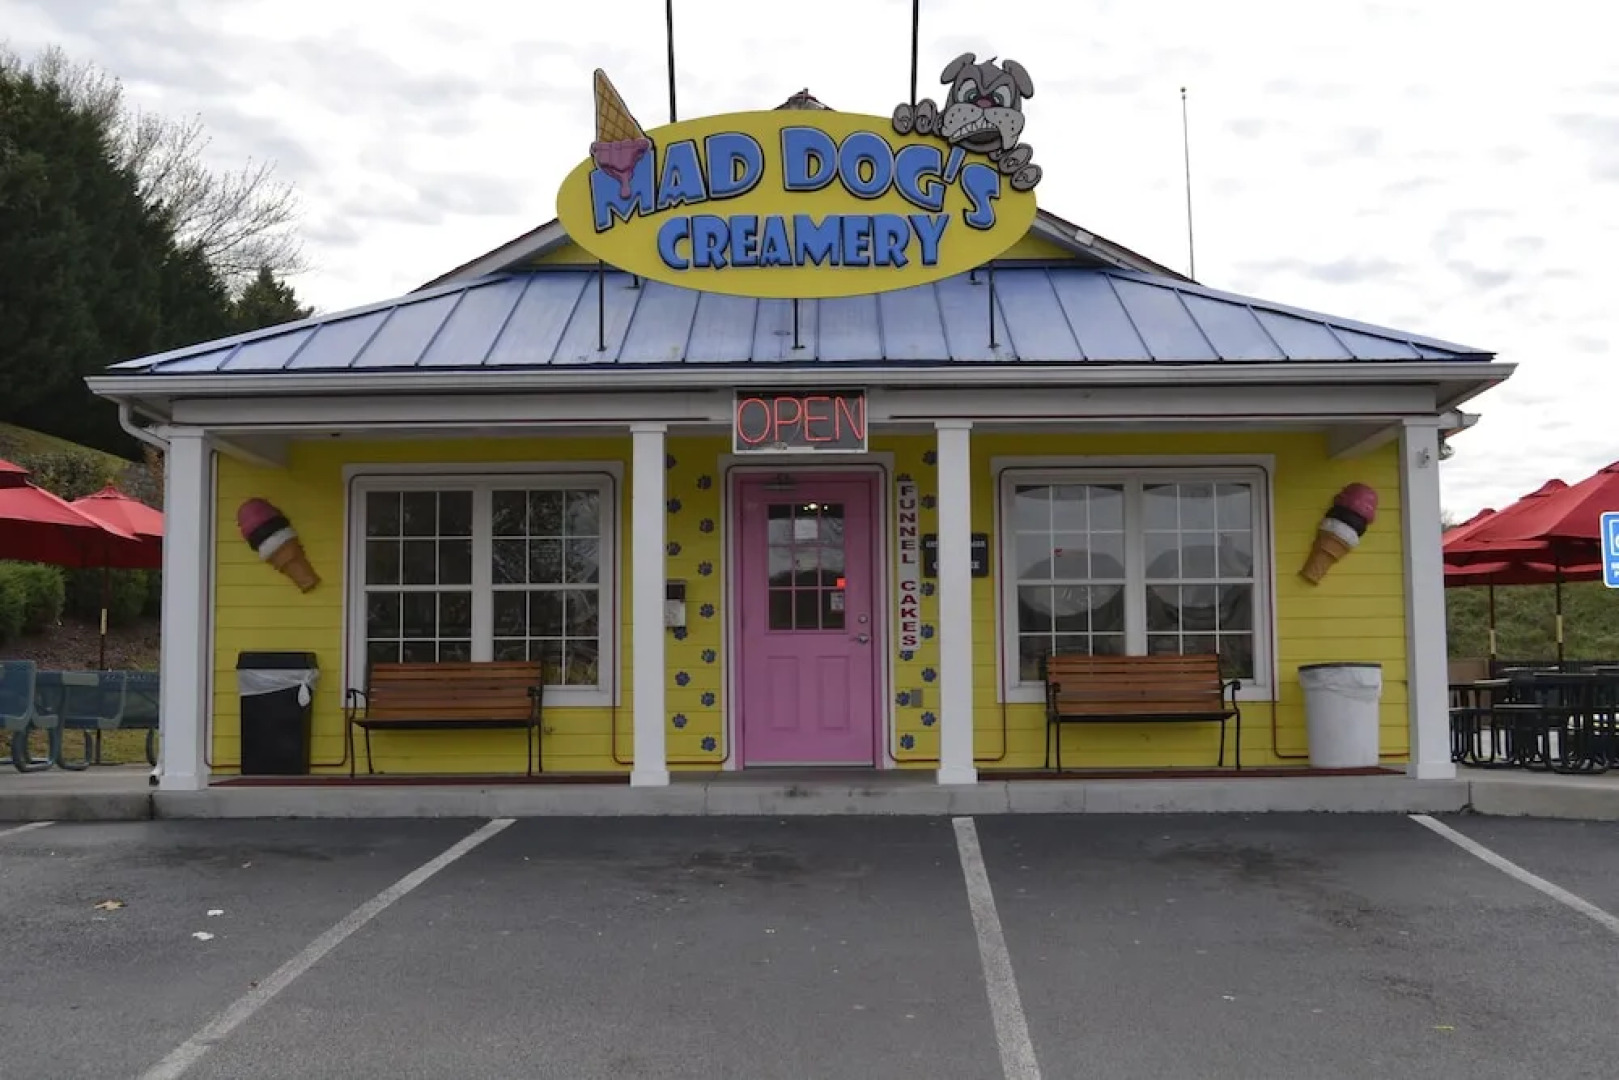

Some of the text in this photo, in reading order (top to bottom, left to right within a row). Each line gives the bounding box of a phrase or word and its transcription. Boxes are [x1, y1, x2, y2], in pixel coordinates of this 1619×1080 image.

[590, 126, 1001, 232] MAD DOG'S
[656, 213, 951, 269] CREAMERY
[737, 394, 865, 444] OPEN
[900, 485, 918, 646] FUNNEL CAKES
